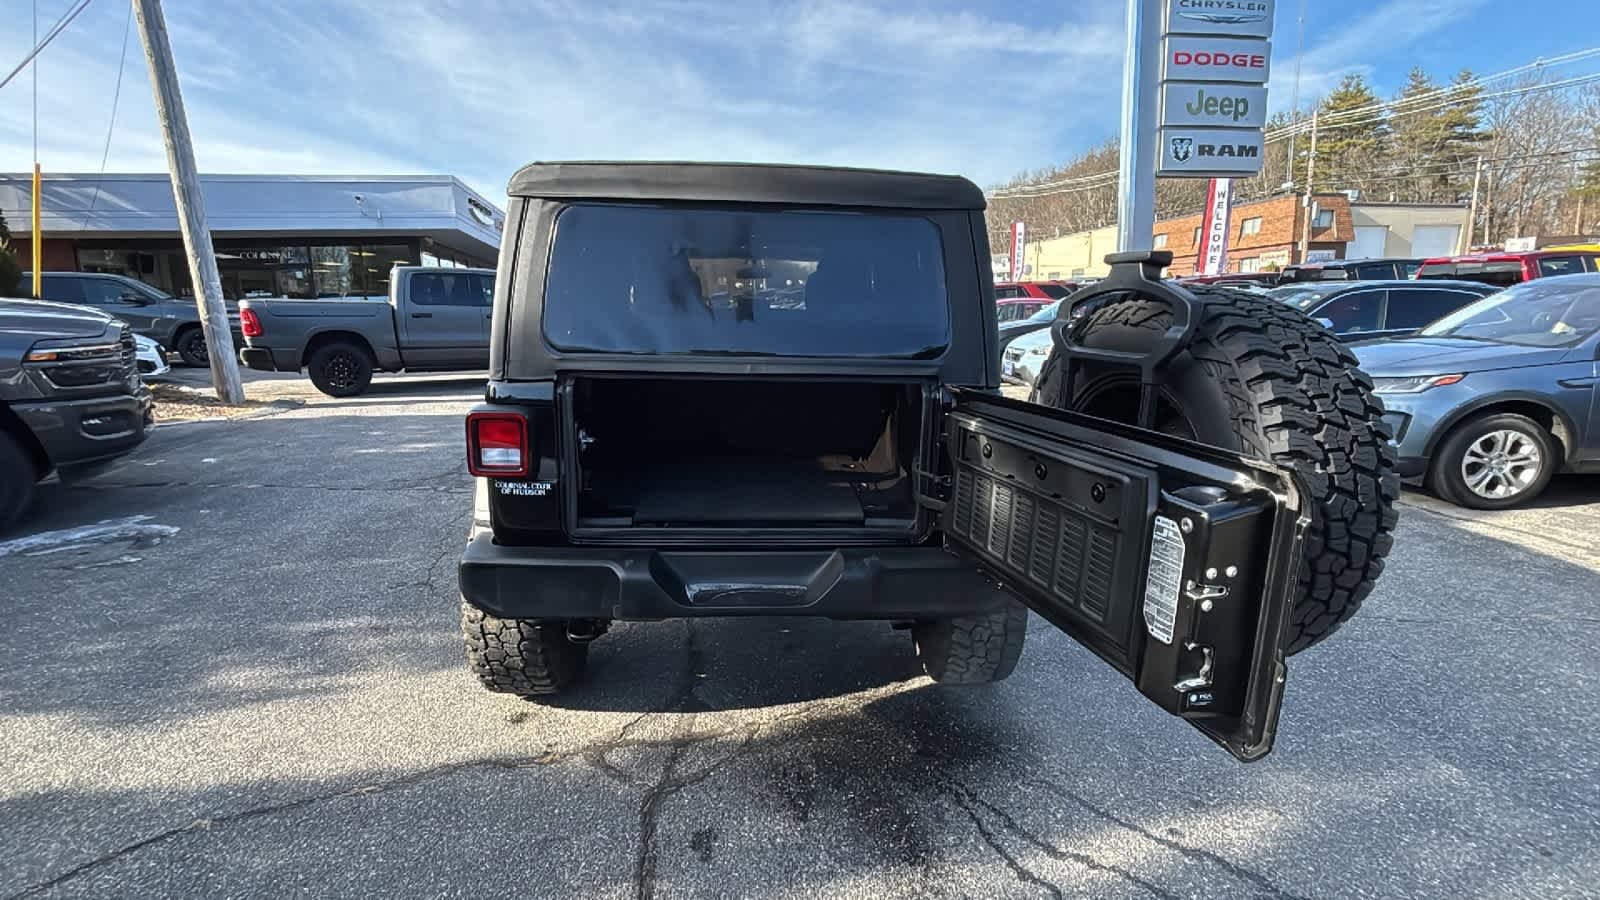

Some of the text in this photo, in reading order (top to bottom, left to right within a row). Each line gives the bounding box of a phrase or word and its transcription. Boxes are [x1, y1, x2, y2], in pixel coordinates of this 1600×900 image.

[1179, 0, 1266, 11] CHRYSLER
[1174, 52, 1265, 68] DODGE
[1186, 88, 1249, 121] Jeep
[1197, 144, 1258, 157] RAM
[1209, 190, 1226, 264] WELCOME
[501, 487, 546, 496] OF HUDSON
